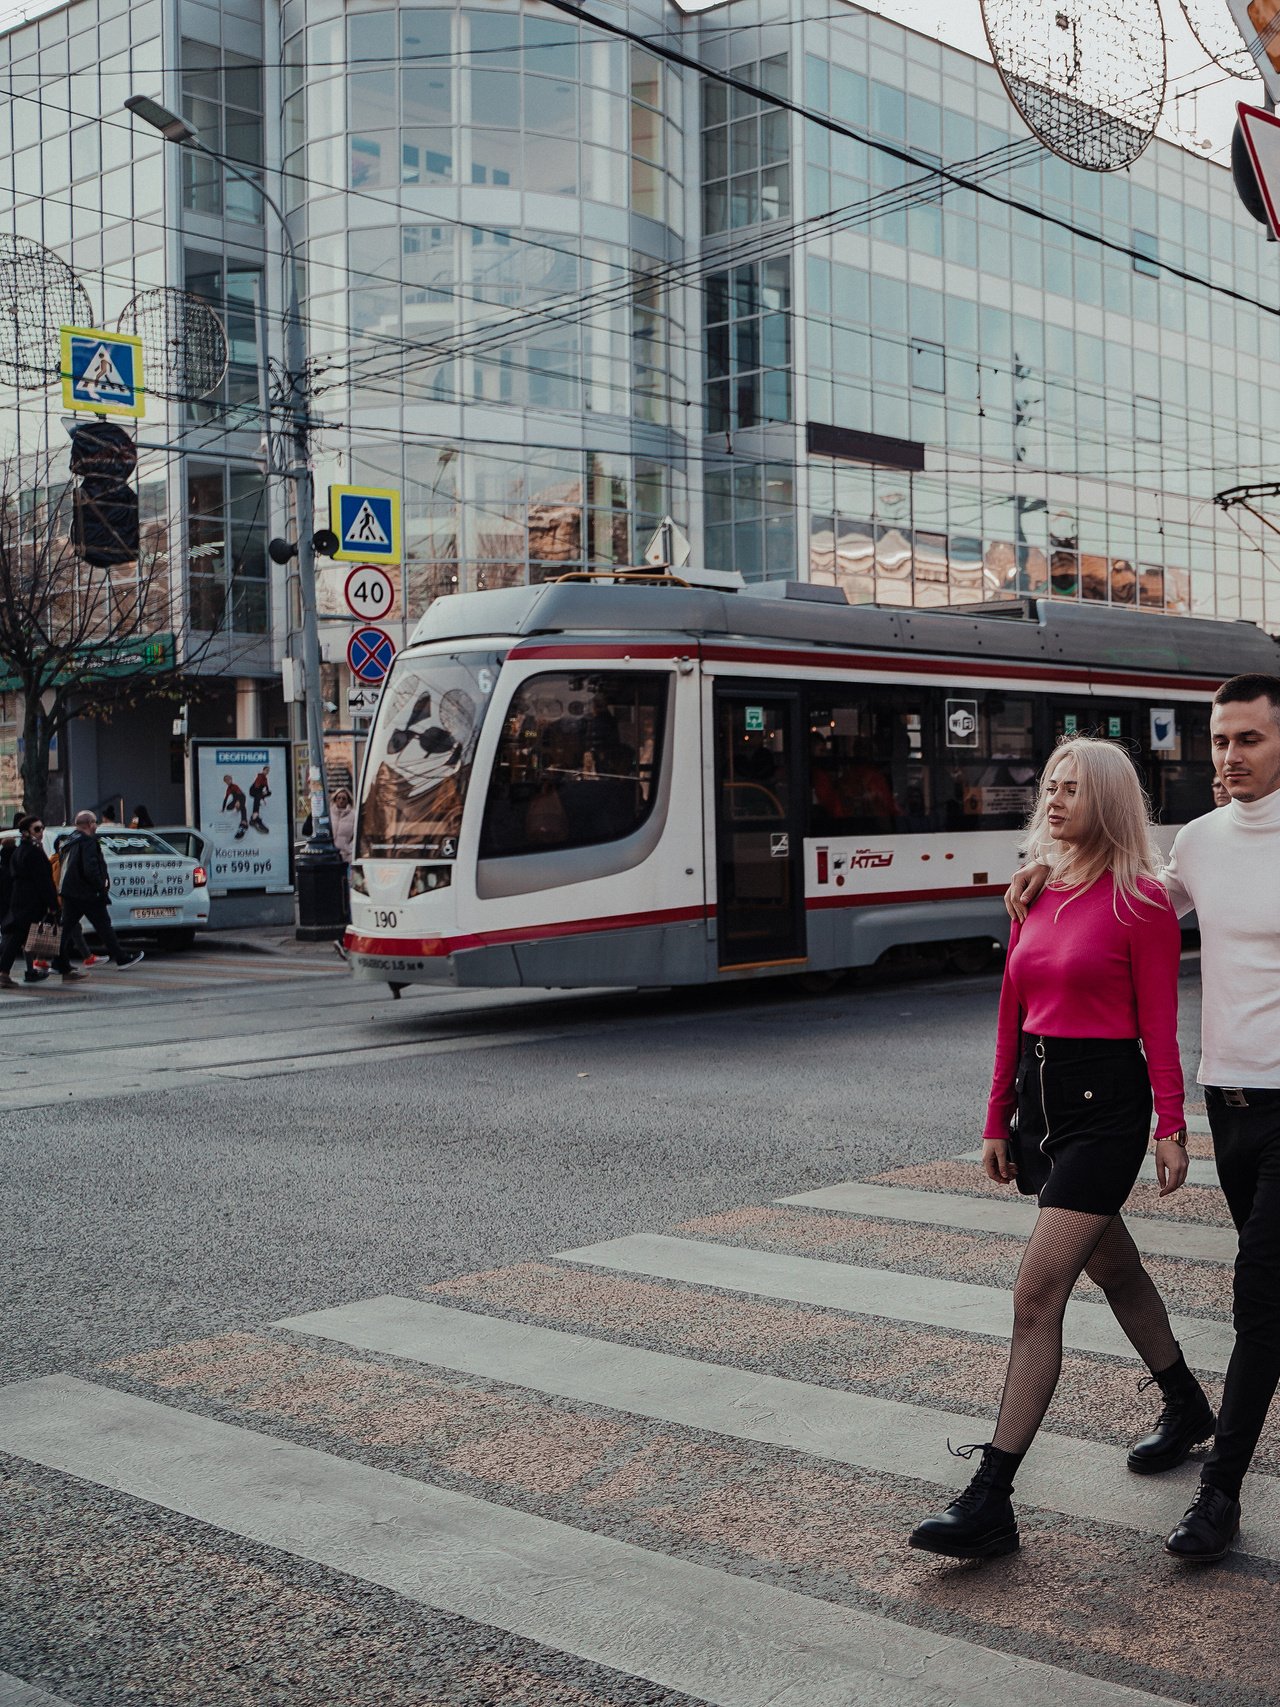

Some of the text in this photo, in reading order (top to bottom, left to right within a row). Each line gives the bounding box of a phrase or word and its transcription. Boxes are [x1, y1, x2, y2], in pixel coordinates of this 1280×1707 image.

[354, 581, 384, 604] 40
[219, 751, 267, 762] DECATHLON
[215, 847, 260, 858] Костюмы
[215, 859, 272, 874] от 599 руб
[113, 875, 183, 886] ОТ 800 РУБ
[119, 885, 184, 897] АРЕНДА АВТО
[374, 911, 397, 928] 190
